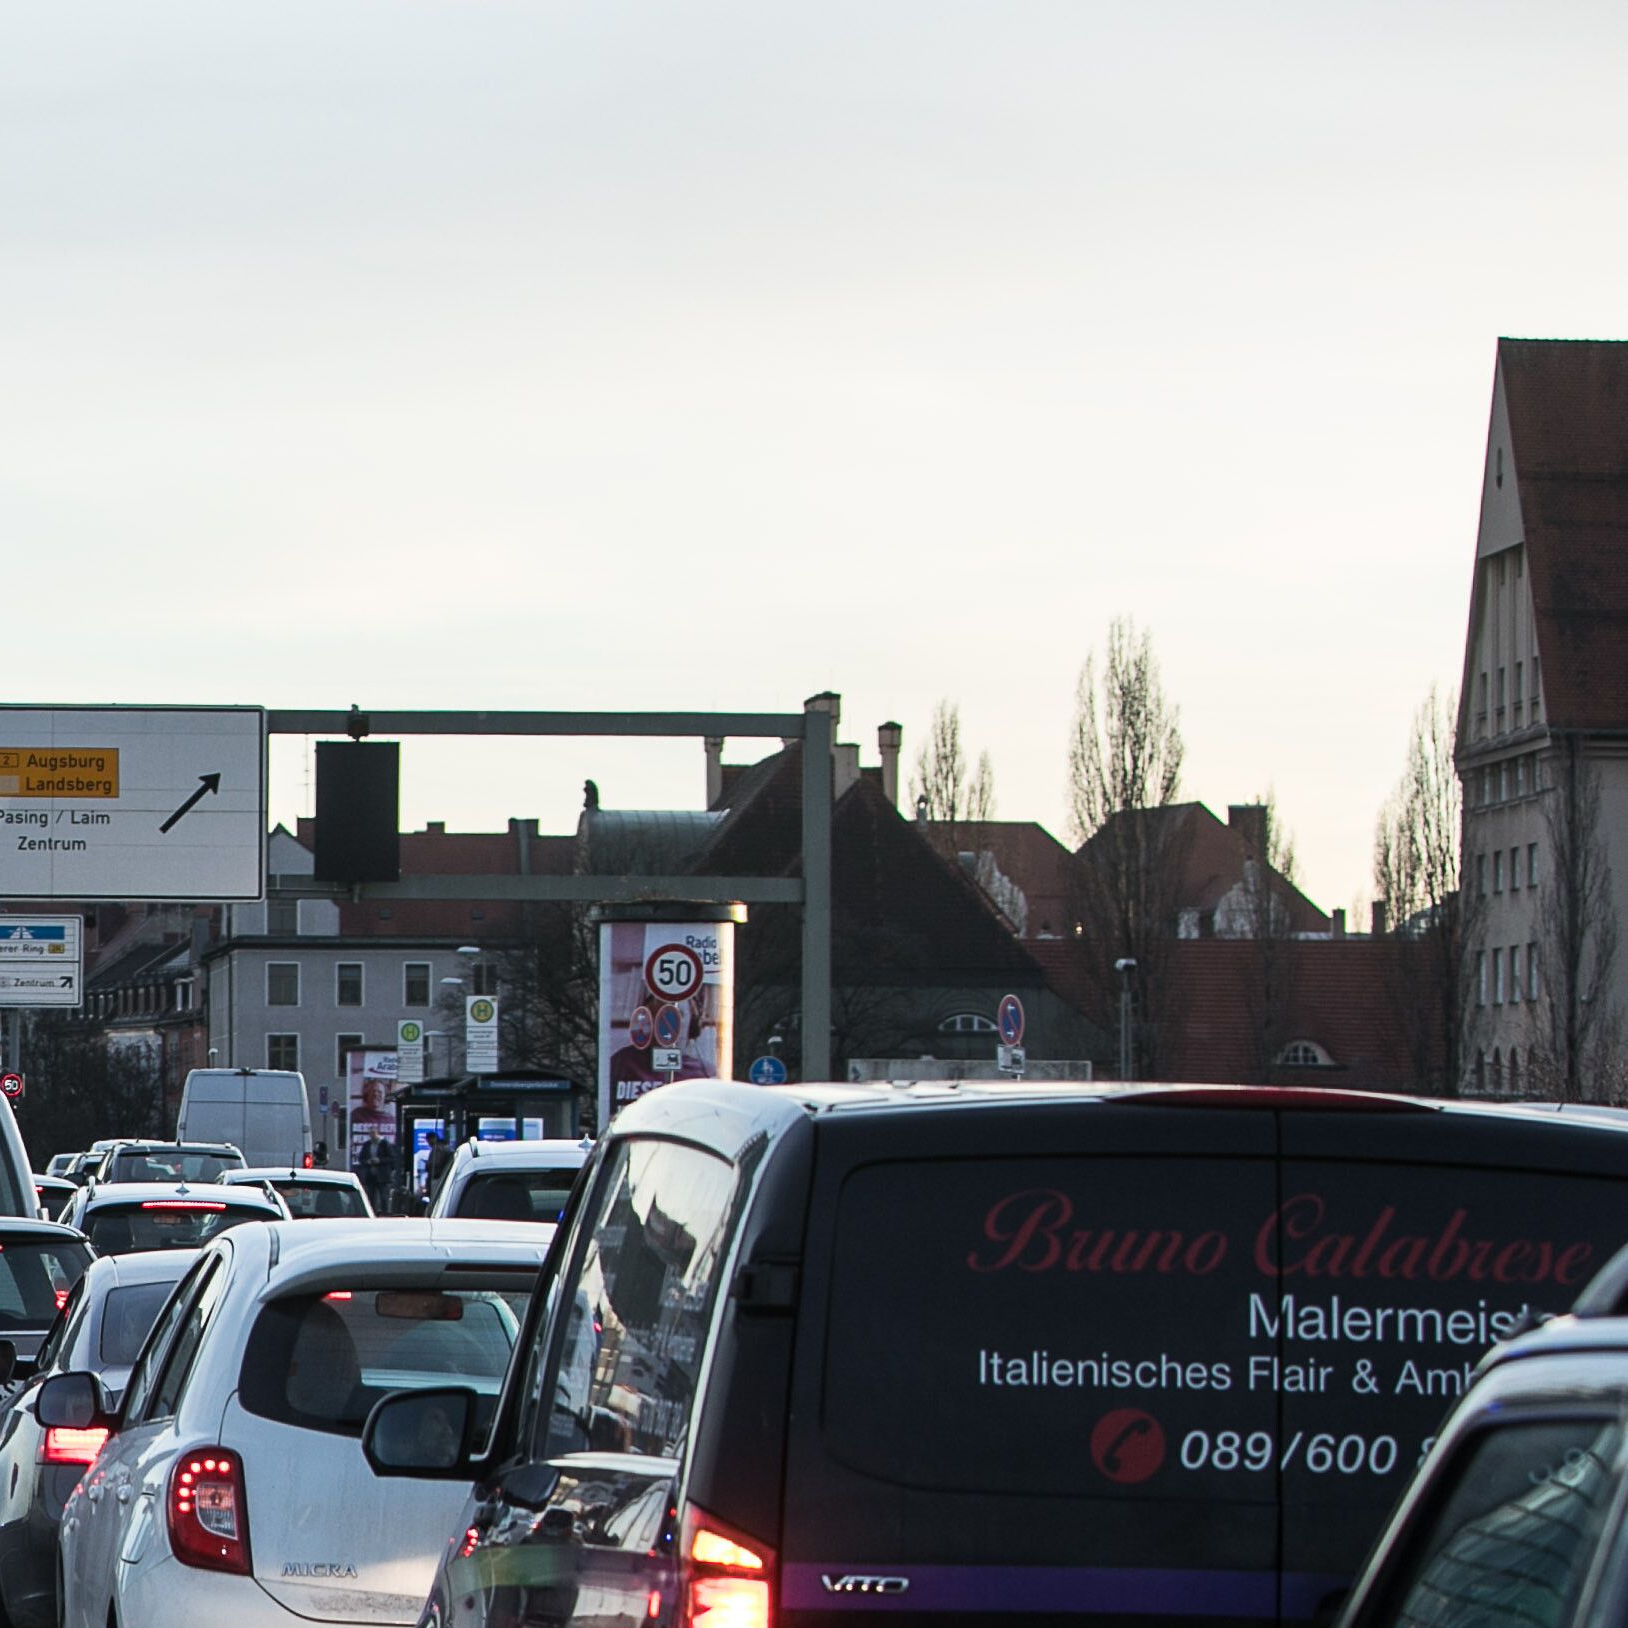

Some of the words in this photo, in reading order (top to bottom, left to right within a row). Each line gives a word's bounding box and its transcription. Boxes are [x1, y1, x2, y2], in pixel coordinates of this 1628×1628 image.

[3, 755, 10, 765] 2
[26, 753, 105, 771] Augsburg
[26, 777, 112, 795] Landsberg
[71, 809, 110, 824] Laim
[18, 836, 86, 850] Zentrum
[23, 943, 44, 955] Ring
[659, 960, 692, 986] 50
[14, 978, 54, 987] Zentrum
[4, 1079, 19, 1091] 50
[967, 1188, 1228, 1275] Bruno
[1253, 1193, 1594, 1286] Calabrese
[1248, 1293, 1557, 1346] Malermeist
[977, 1349, 1232, 1391] Italienisches
[1248, 1355, 1334, 1395] Flair
[1351, 1360, 1380, 1396] &
[1180, 1430, 1399, 1476] 089/600
[281, 1562, 358, 1578] MICRA
[821, 1574, 909, 1593] VITO
